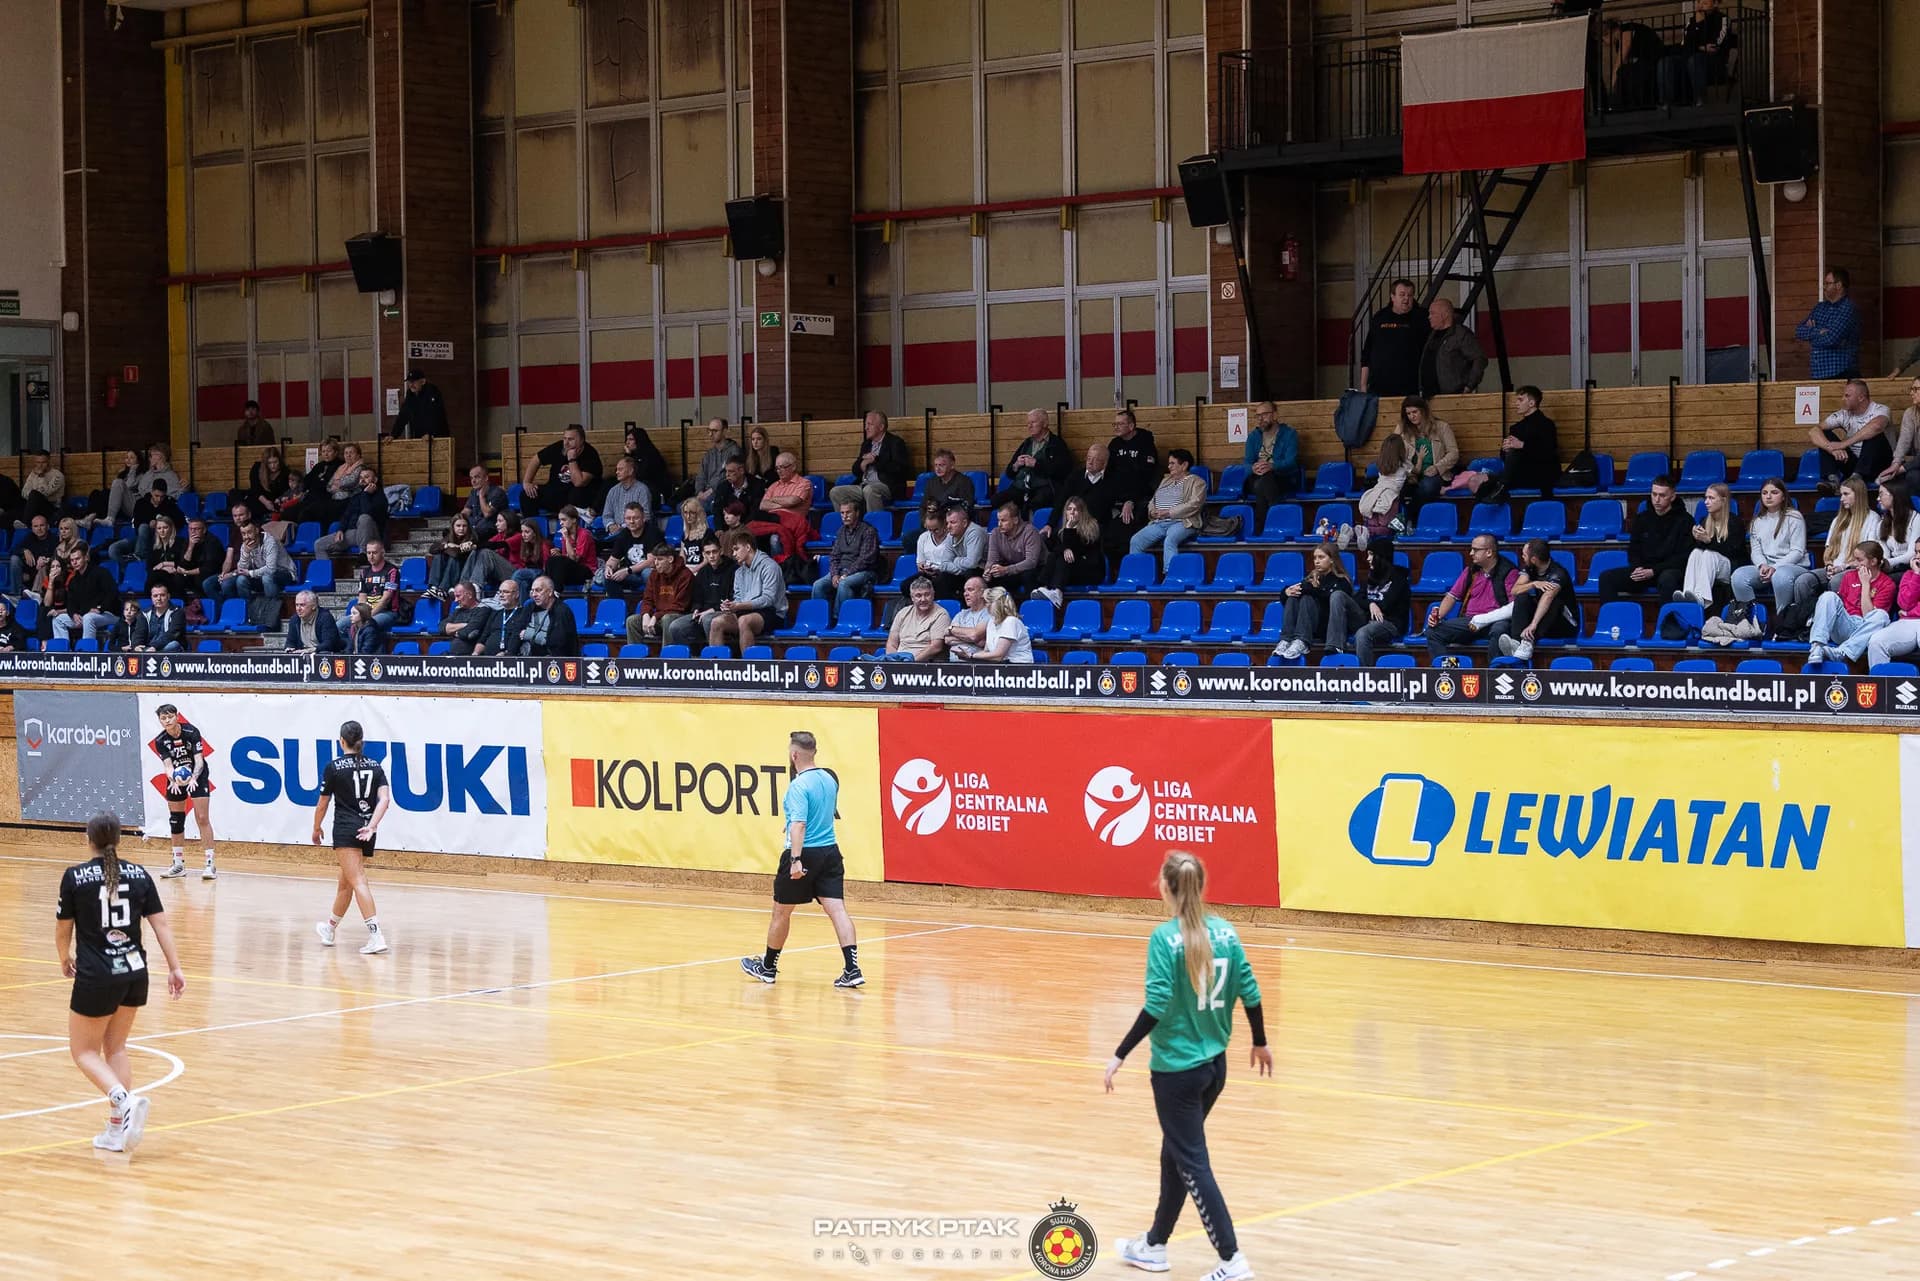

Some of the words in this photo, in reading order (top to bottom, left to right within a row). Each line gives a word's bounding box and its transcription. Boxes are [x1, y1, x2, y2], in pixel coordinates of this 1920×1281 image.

[792, 321, 807, 333] A
[793, 315, 831, 323] SEKTOR
[411, 348, 423, 357] B
[1802, 403, 1812, 416] A
[1233, 423, 1242, 436] A
[174, 655, 315, 680] www.koronahandball.pl
[386, 660, 543, 683] www.koronahandball.pl
[623, 662, 799, 688] www.koronahandball.pl
[891, 668, 1092, 695] www.koronahandball.pl
[1197, 671, 1427, 699] www.koronahandball.pl
[1549, 676, 1816, 710] www.koronahandball.pl
[1859, 692, 1873, 706] CK
[47, 723, 121, 746] karabela
[174, 747, 187, 758] 25
[230, 735, 531, 817] SUUKI
[353, 769, 373, 799] 17
[954, 772, 990, 790] LIGA
[597, 759, 842, 820] KOLPORT
[1153, 780, 1193, 799] LIGA
[955, 794, 1049, 814] CENTRALNA
[1154, 803, 1258, 823] CENTRALNA
[956, 814, 1011, 832] KOBIET
[1464, 785, 1831, 871] LEWIATAN
[1154, 824, 1216, 843] KOBIET
[74, 865, 102, 879] UKS
[98, 883, 131, 928] 15
